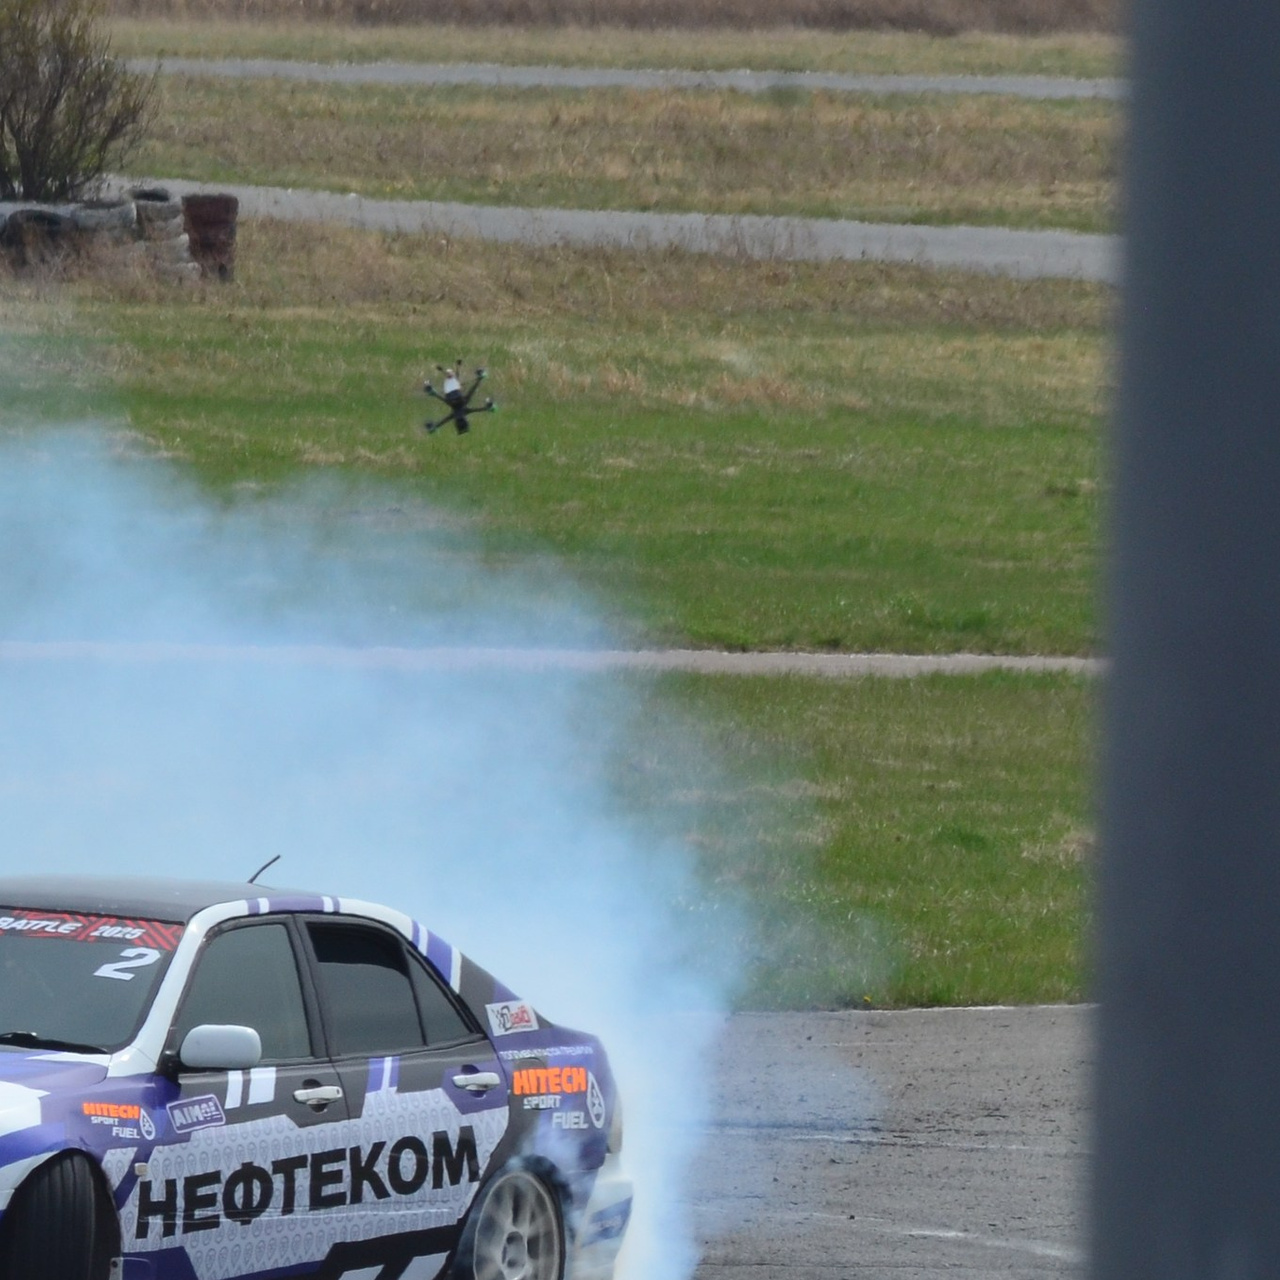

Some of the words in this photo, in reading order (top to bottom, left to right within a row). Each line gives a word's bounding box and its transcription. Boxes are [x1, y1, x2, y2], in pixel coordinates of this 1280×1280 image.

[90, 925, 146, 939] 2025
[93, 947, 161, 981] 2
[513, 1066, 587, 1095] HITECH
[83, 1102, 140, 1119] HITECH
[523, 1095, 562, 1109] SPORT
[91, 1116, 119, 1125] SPORT
[552, 1111, 589, 1129] FUEL
[112, 1127, 140, 1139] FUEL
[135, 1126, 480, 1239] НЕФТЕКОМ
